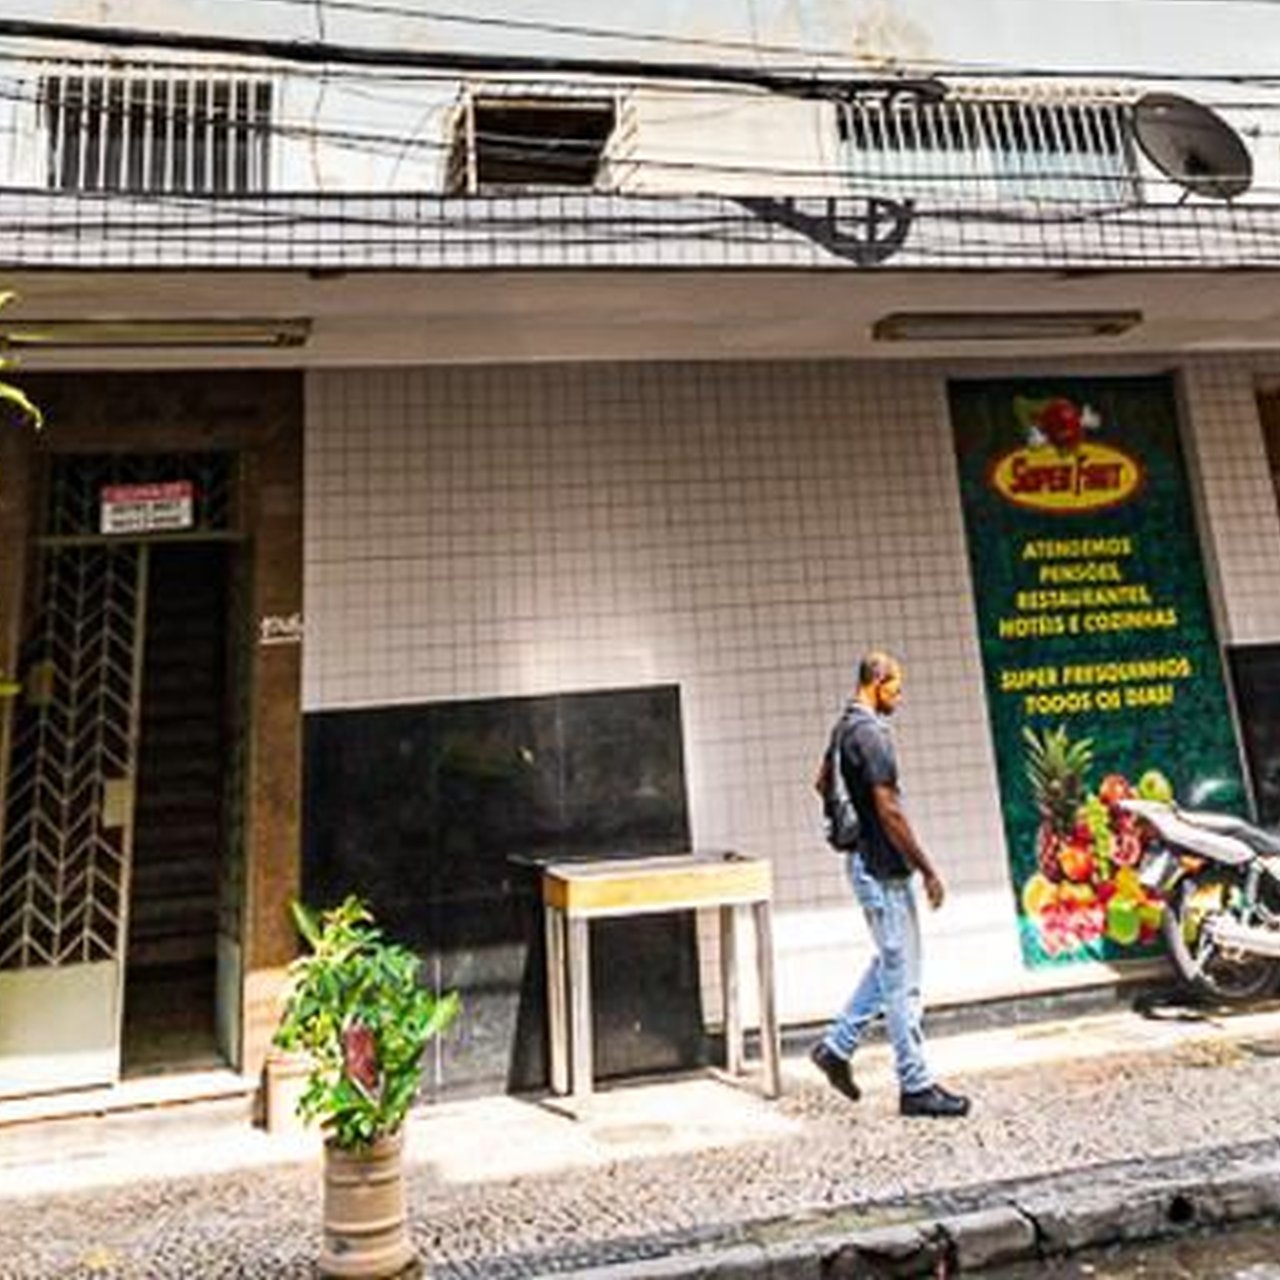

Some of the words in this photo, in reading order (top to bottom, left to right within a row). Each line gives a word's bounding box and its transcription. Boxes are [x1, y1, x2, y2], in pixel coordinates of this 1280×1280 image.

[1023, 538, 1131, 559] ATENDEMOS
[1082, 607, 1177, 631] COZINHAS
[1001, 667, 1058, 692] SUPER
[1062, 658, 1190, 684] FRESQUINHOS
[1025, 692, 1093, 715] TODOS
